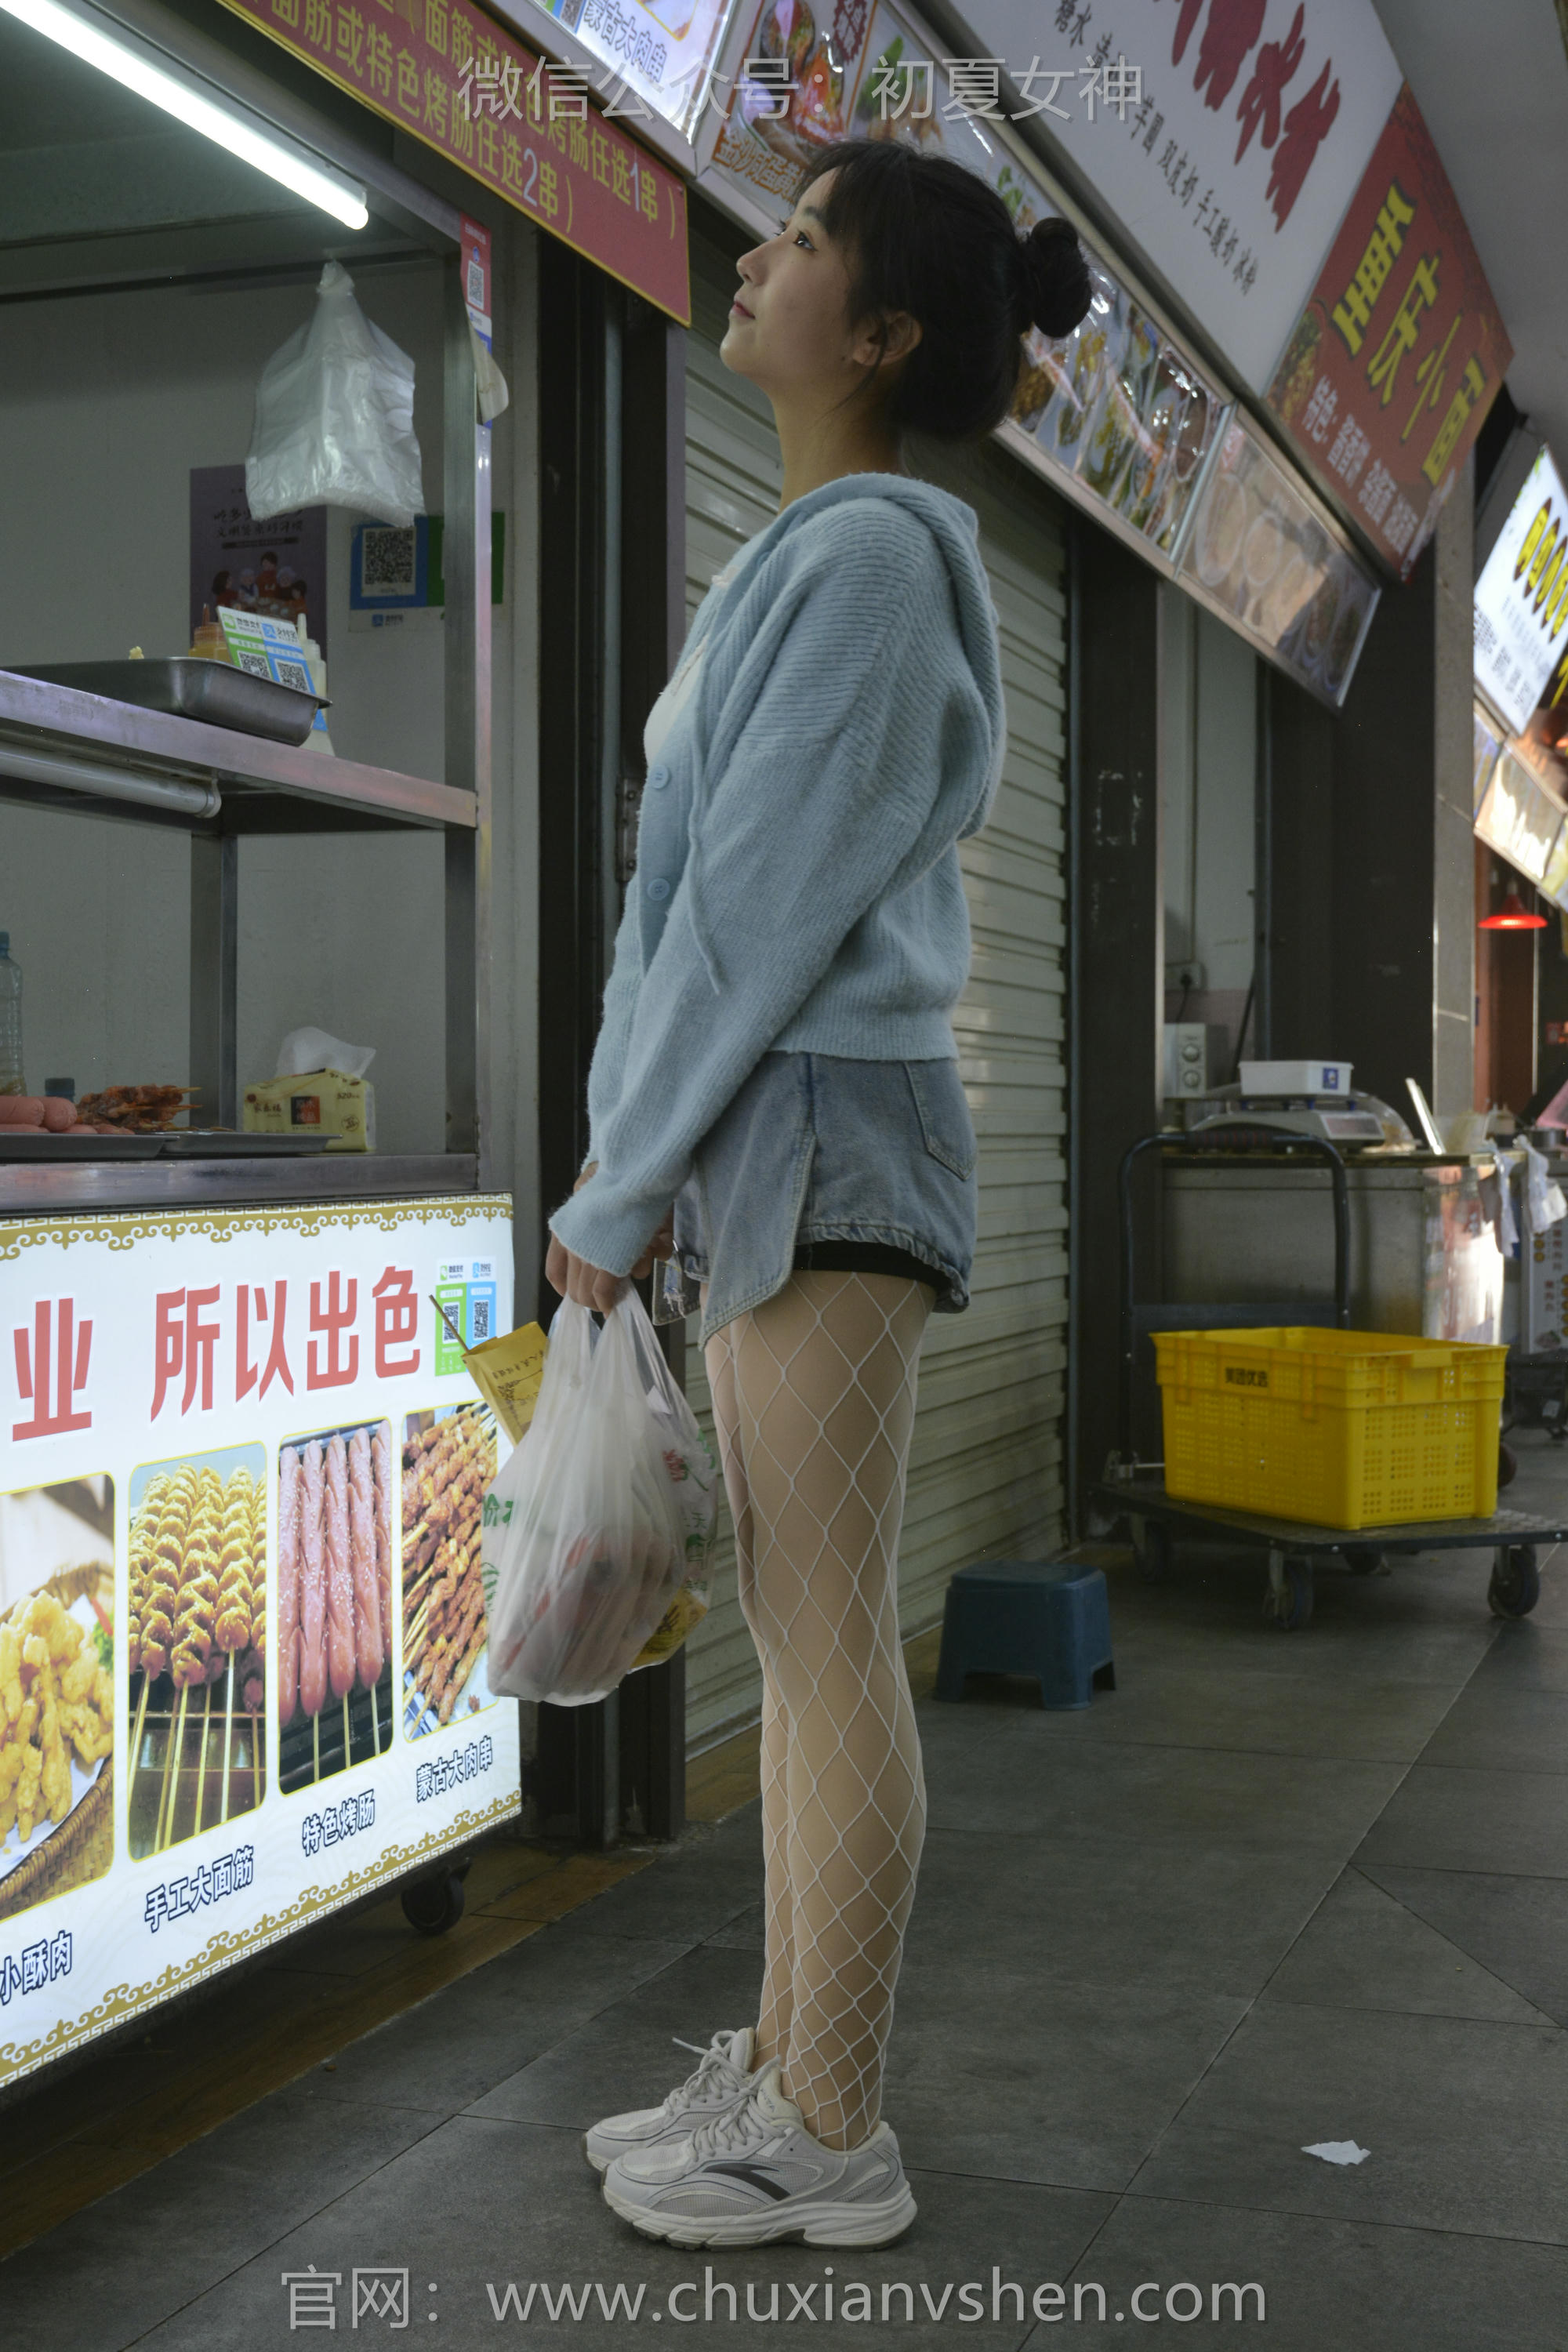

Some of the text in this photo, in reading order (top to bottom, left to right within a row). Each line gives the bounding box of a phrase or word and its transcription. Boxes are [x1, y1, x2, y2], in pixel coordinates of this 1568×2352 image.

[1331, 178, 1487, 486] 重庆小面
[12, 1265, 420, 1442] 业 所以出色
[416, 1734, 492, 1802] 蒙古大肉串
[302, 1788, 376, 1857] 特色烤肠
[144, 1844, 255, 1933] 手工大面筋
[0, 1929, 73, 2006] 小酥肉
